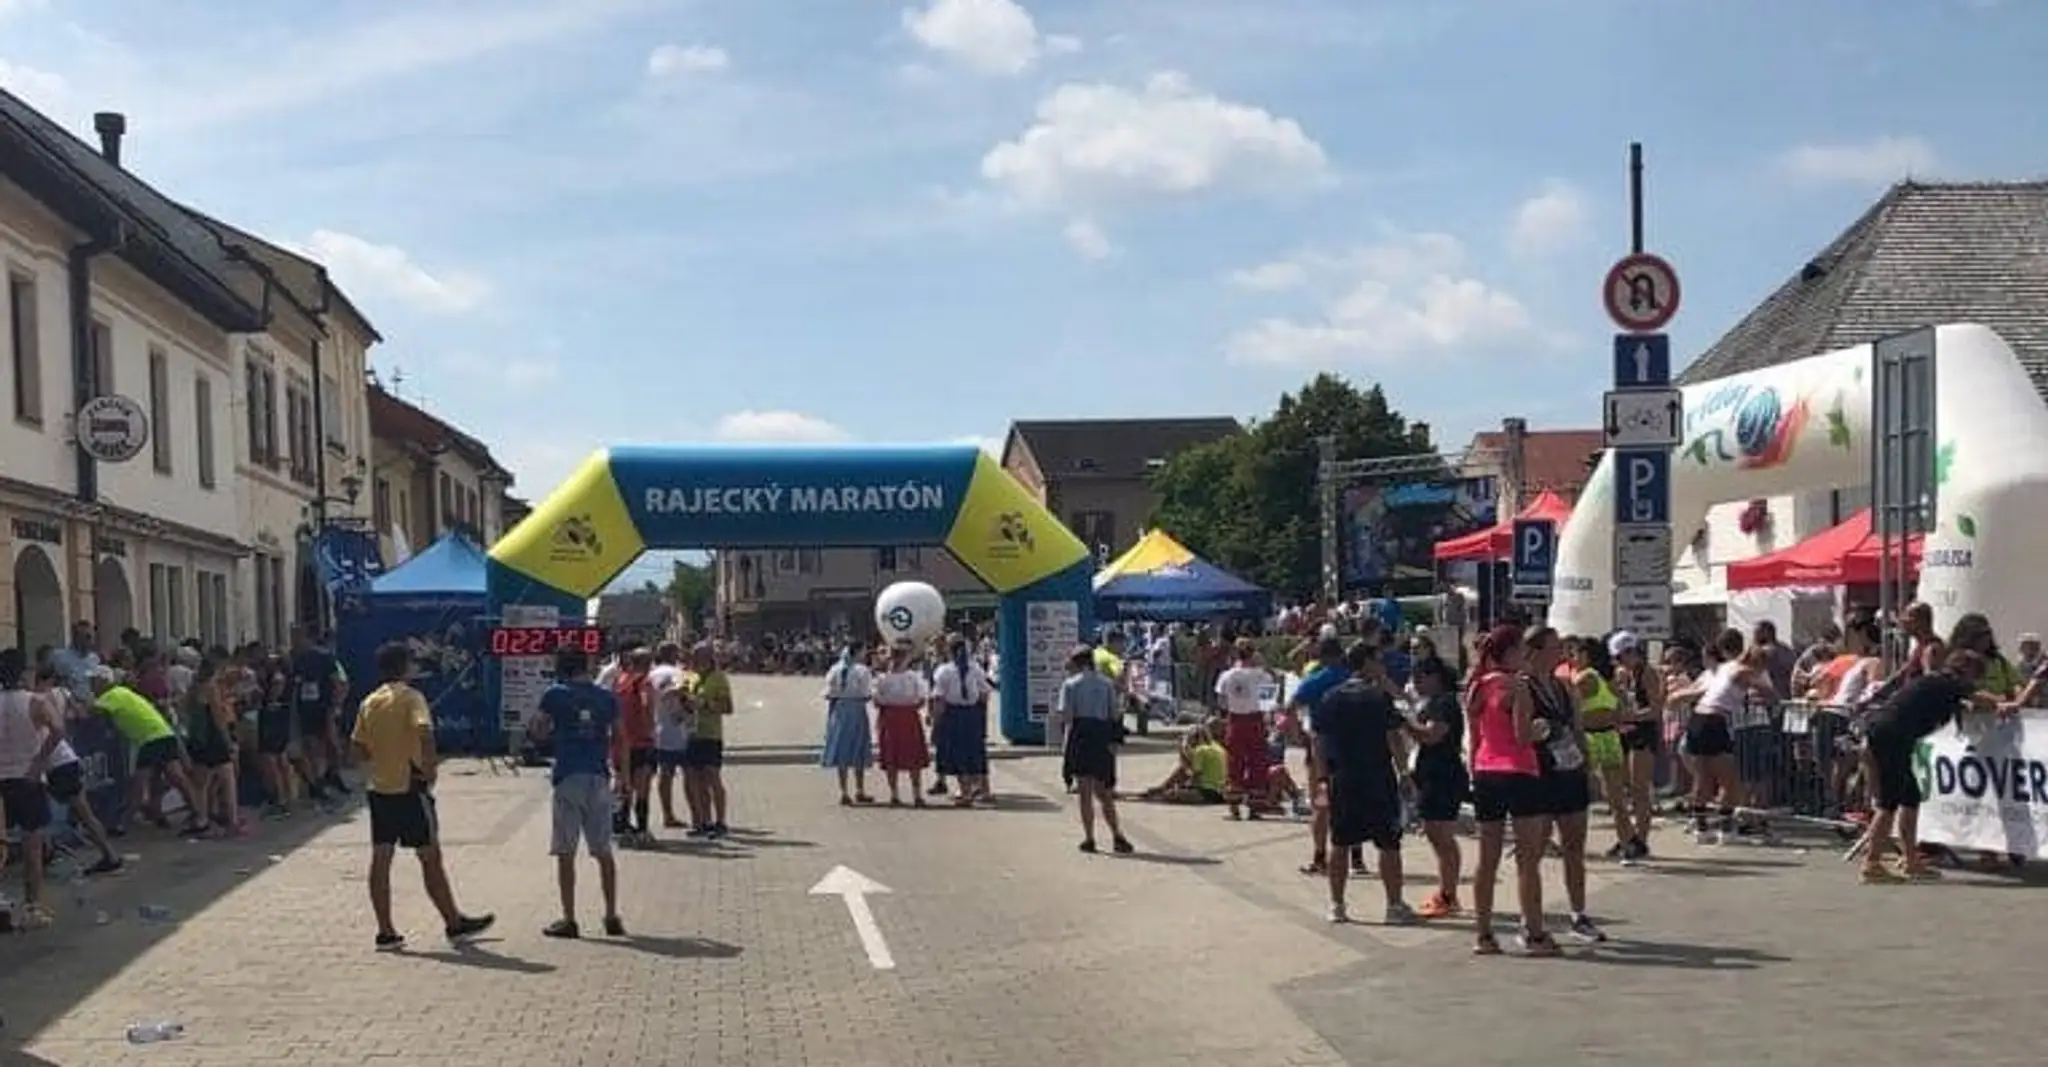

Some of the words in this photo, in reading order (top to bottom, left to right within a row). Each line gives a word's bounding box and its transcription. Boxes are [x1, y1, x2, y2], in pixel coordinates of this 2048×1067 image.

[645, 484, 783, 513] RAJECKÝ
[790, 480, 943, 512] MARATÓN
[1630, 458, 1655, 500] P
[1524, 526, 1543, 564] P
[1935, 745, 2048, 804] DÔVER
